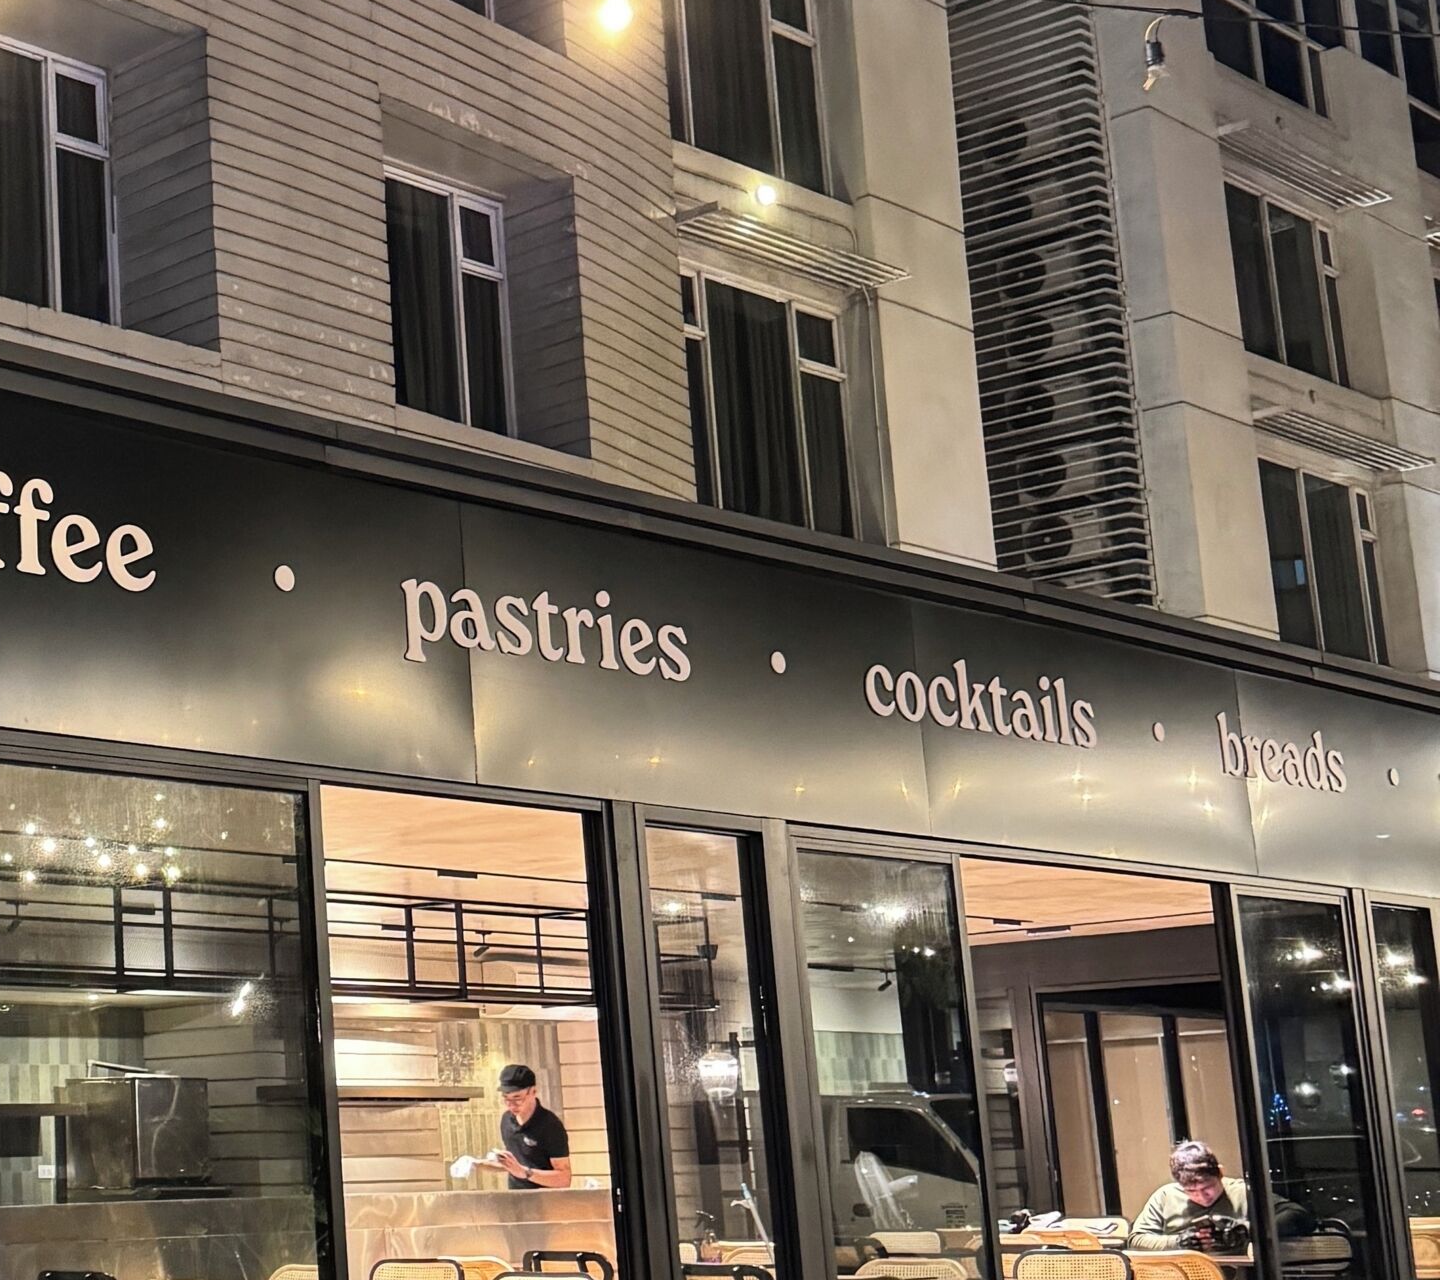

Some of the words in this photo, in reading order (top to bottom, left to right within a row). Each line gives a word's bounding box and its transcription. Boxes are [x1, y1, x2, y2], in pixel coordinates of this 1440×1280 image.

[401, 577, 692, 682] pastries
[865, 659, 1096, 749] cocktails
[1216, 712, 1347, 793] breads
